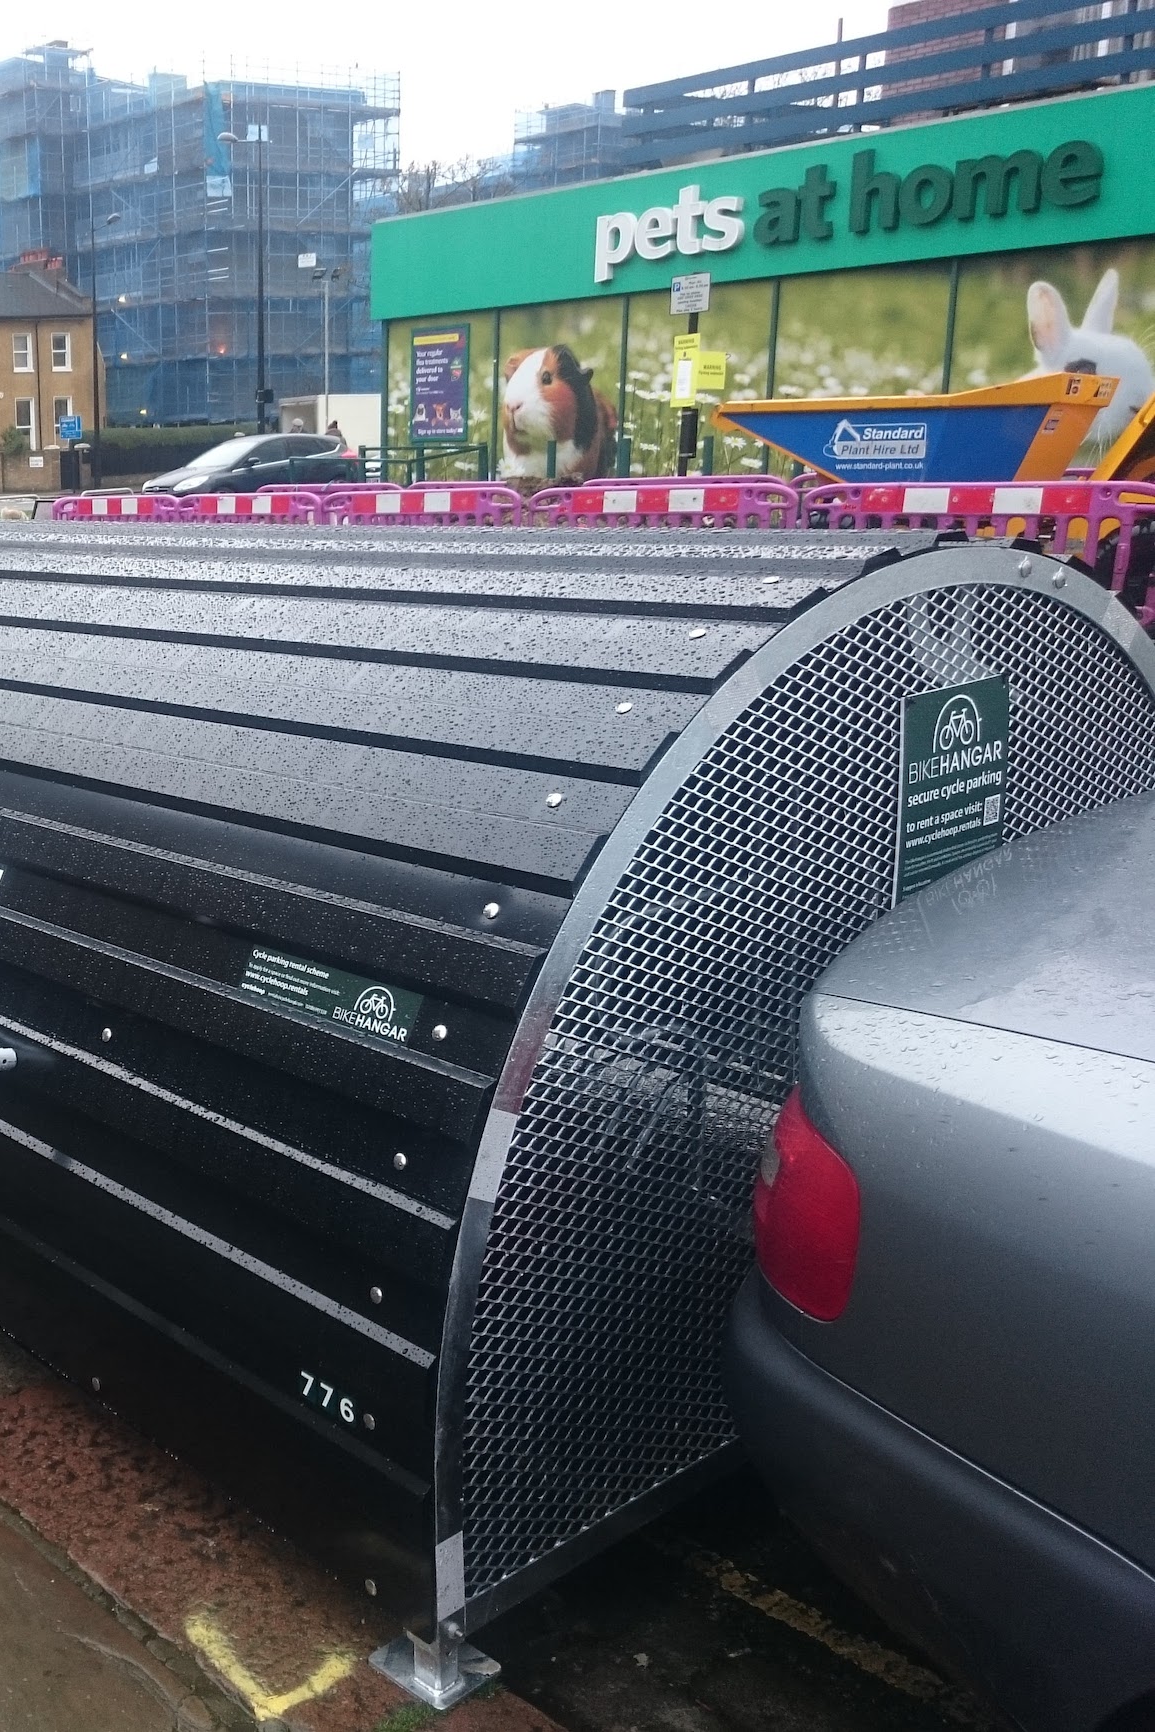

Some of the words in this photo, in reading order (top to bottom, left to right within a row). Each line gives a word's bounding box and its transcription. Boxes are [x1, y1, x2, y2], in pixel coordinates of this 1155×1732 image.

[594, 184, 744, 283] pets
[753, 163, 837, 248] at
[849, 140, 1105, 236] home
[841, 444, 870, 455] Plant
[873, 444, 897, 455] Hire
[900, 443, 920, 455] Ltd
[862, 426, 924, 440] Standard
[835, 461, 924, 471] www.standard-plant.co.uk
[908, 740, 1002, 785] BIKEHANGAR
[907, 787, 940, 808] secure
[941, 778, 965, 800] cycle
[966, 770, 1002, 794] parking
[905, 817, 982, 849] www.cyclehoop.rentals
[906, 821, 915, 834] to
[916, 816, 934, 831] rent
[934, 815, 940, 825] a
[940, 808, 964, 827] space
[964, 801, 983, 818] visit:
[252, 949, 267, 959] Cycle
[266, 954, 289, 968] parking
[289, 961, 307, 972] rental
[306, 966, 330, 979] scheme
[245, 970, 308, 996] www.cyclehoop.rentals
[332, 1006, 408, 1042] BIKEHANGAR
[300, 1370, 355, 1423] 776
